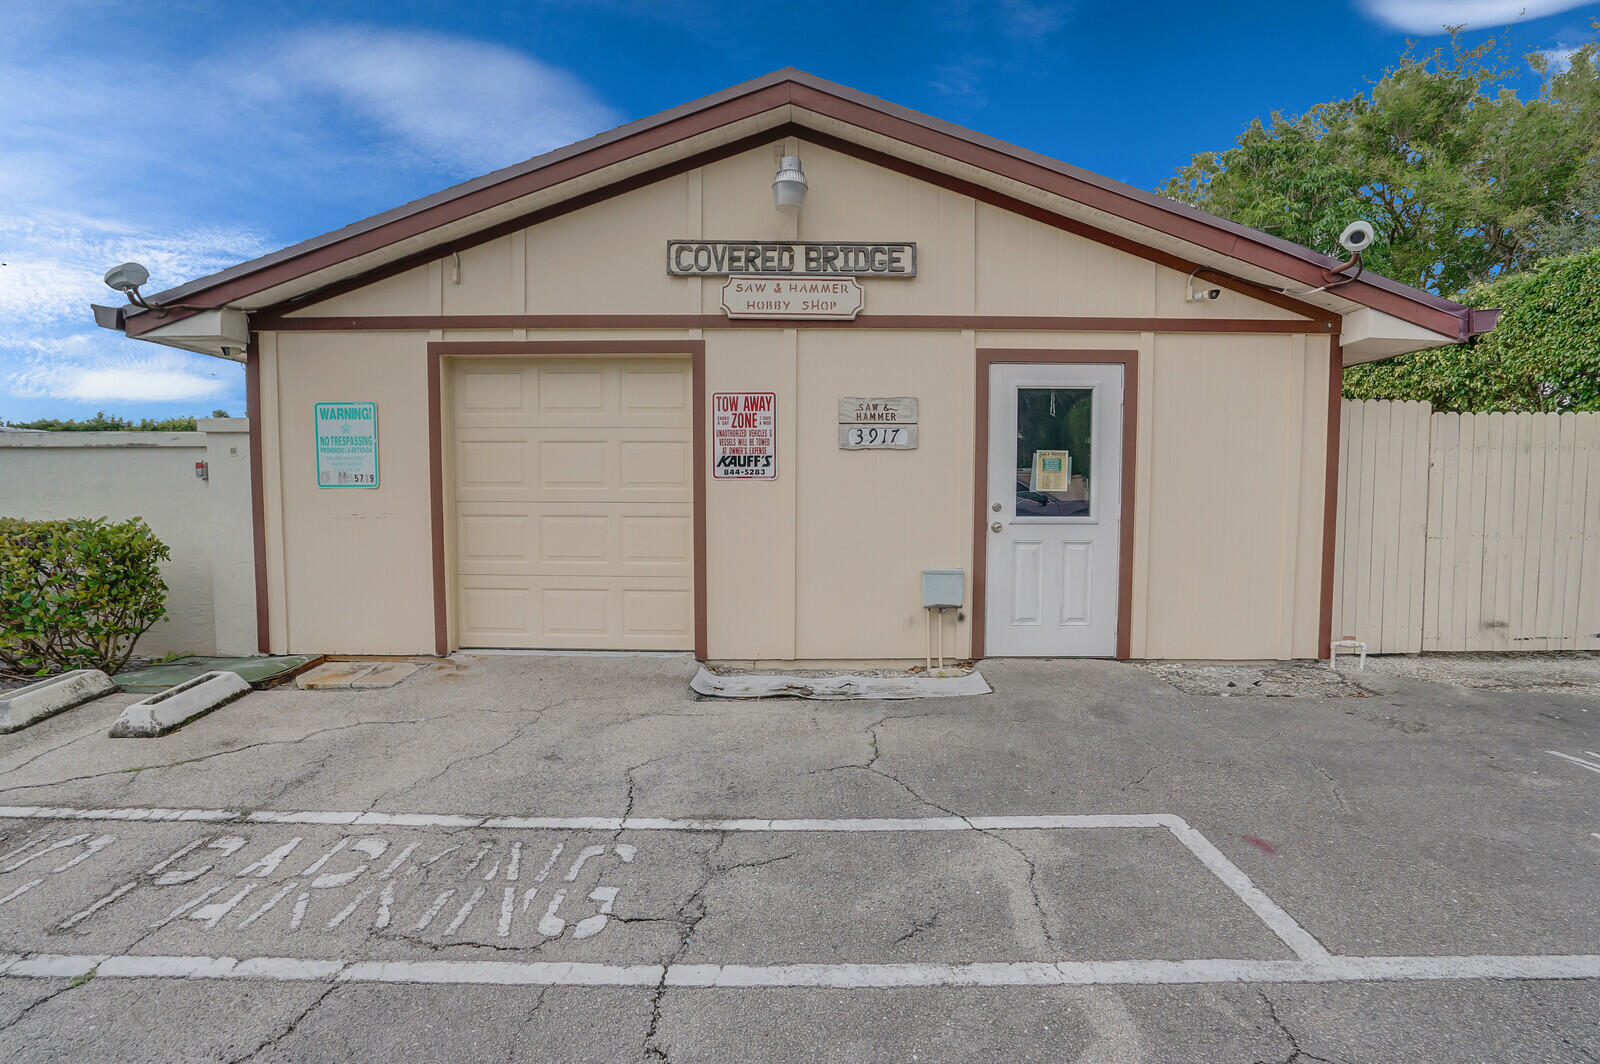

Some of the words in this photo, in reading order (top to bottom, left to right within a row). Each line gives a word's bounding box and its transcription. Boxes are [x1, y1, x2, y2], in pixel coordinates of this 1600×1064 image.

[675, 245, 794, 272] COVERED
[804, 246, 905, 272] BRIDGE
[735, 283, 767, 293] SAW
[773, 283, 782, 293] &
[789, 283, 849, 294] HAMMER
[746, 301, 791, 311] HOBBY
[802, 301, 838, 311] SHOP
[716, 396, 738, 412] TOW
[743, 396, 772, 411] AWAY
[857, 403, 878, 411] SAW
[319, 407, 372, 420] WARNING!
[856, 412, 897, 421] HAMMER
[731, 413, 757, 428] ZONE
[716, 429, 747, 437] UNAUTHORIZED
[749, 429, 767, 437] VEHICLES
[855, 428, 900, 445] 3917
[320, 436, 329, 446] NO
[330, 436, 373, 446] TRESPASSING
[719, 438, 736, 446] VESSELS
[738, 438, 747, 446] WILL
[749, 438, 755, 446] BE
[756, 438, 770, 446] TOWED
[749, 447, 767, 455] EXPENSE
[716, 455, 773, 467] KAUFF'S
